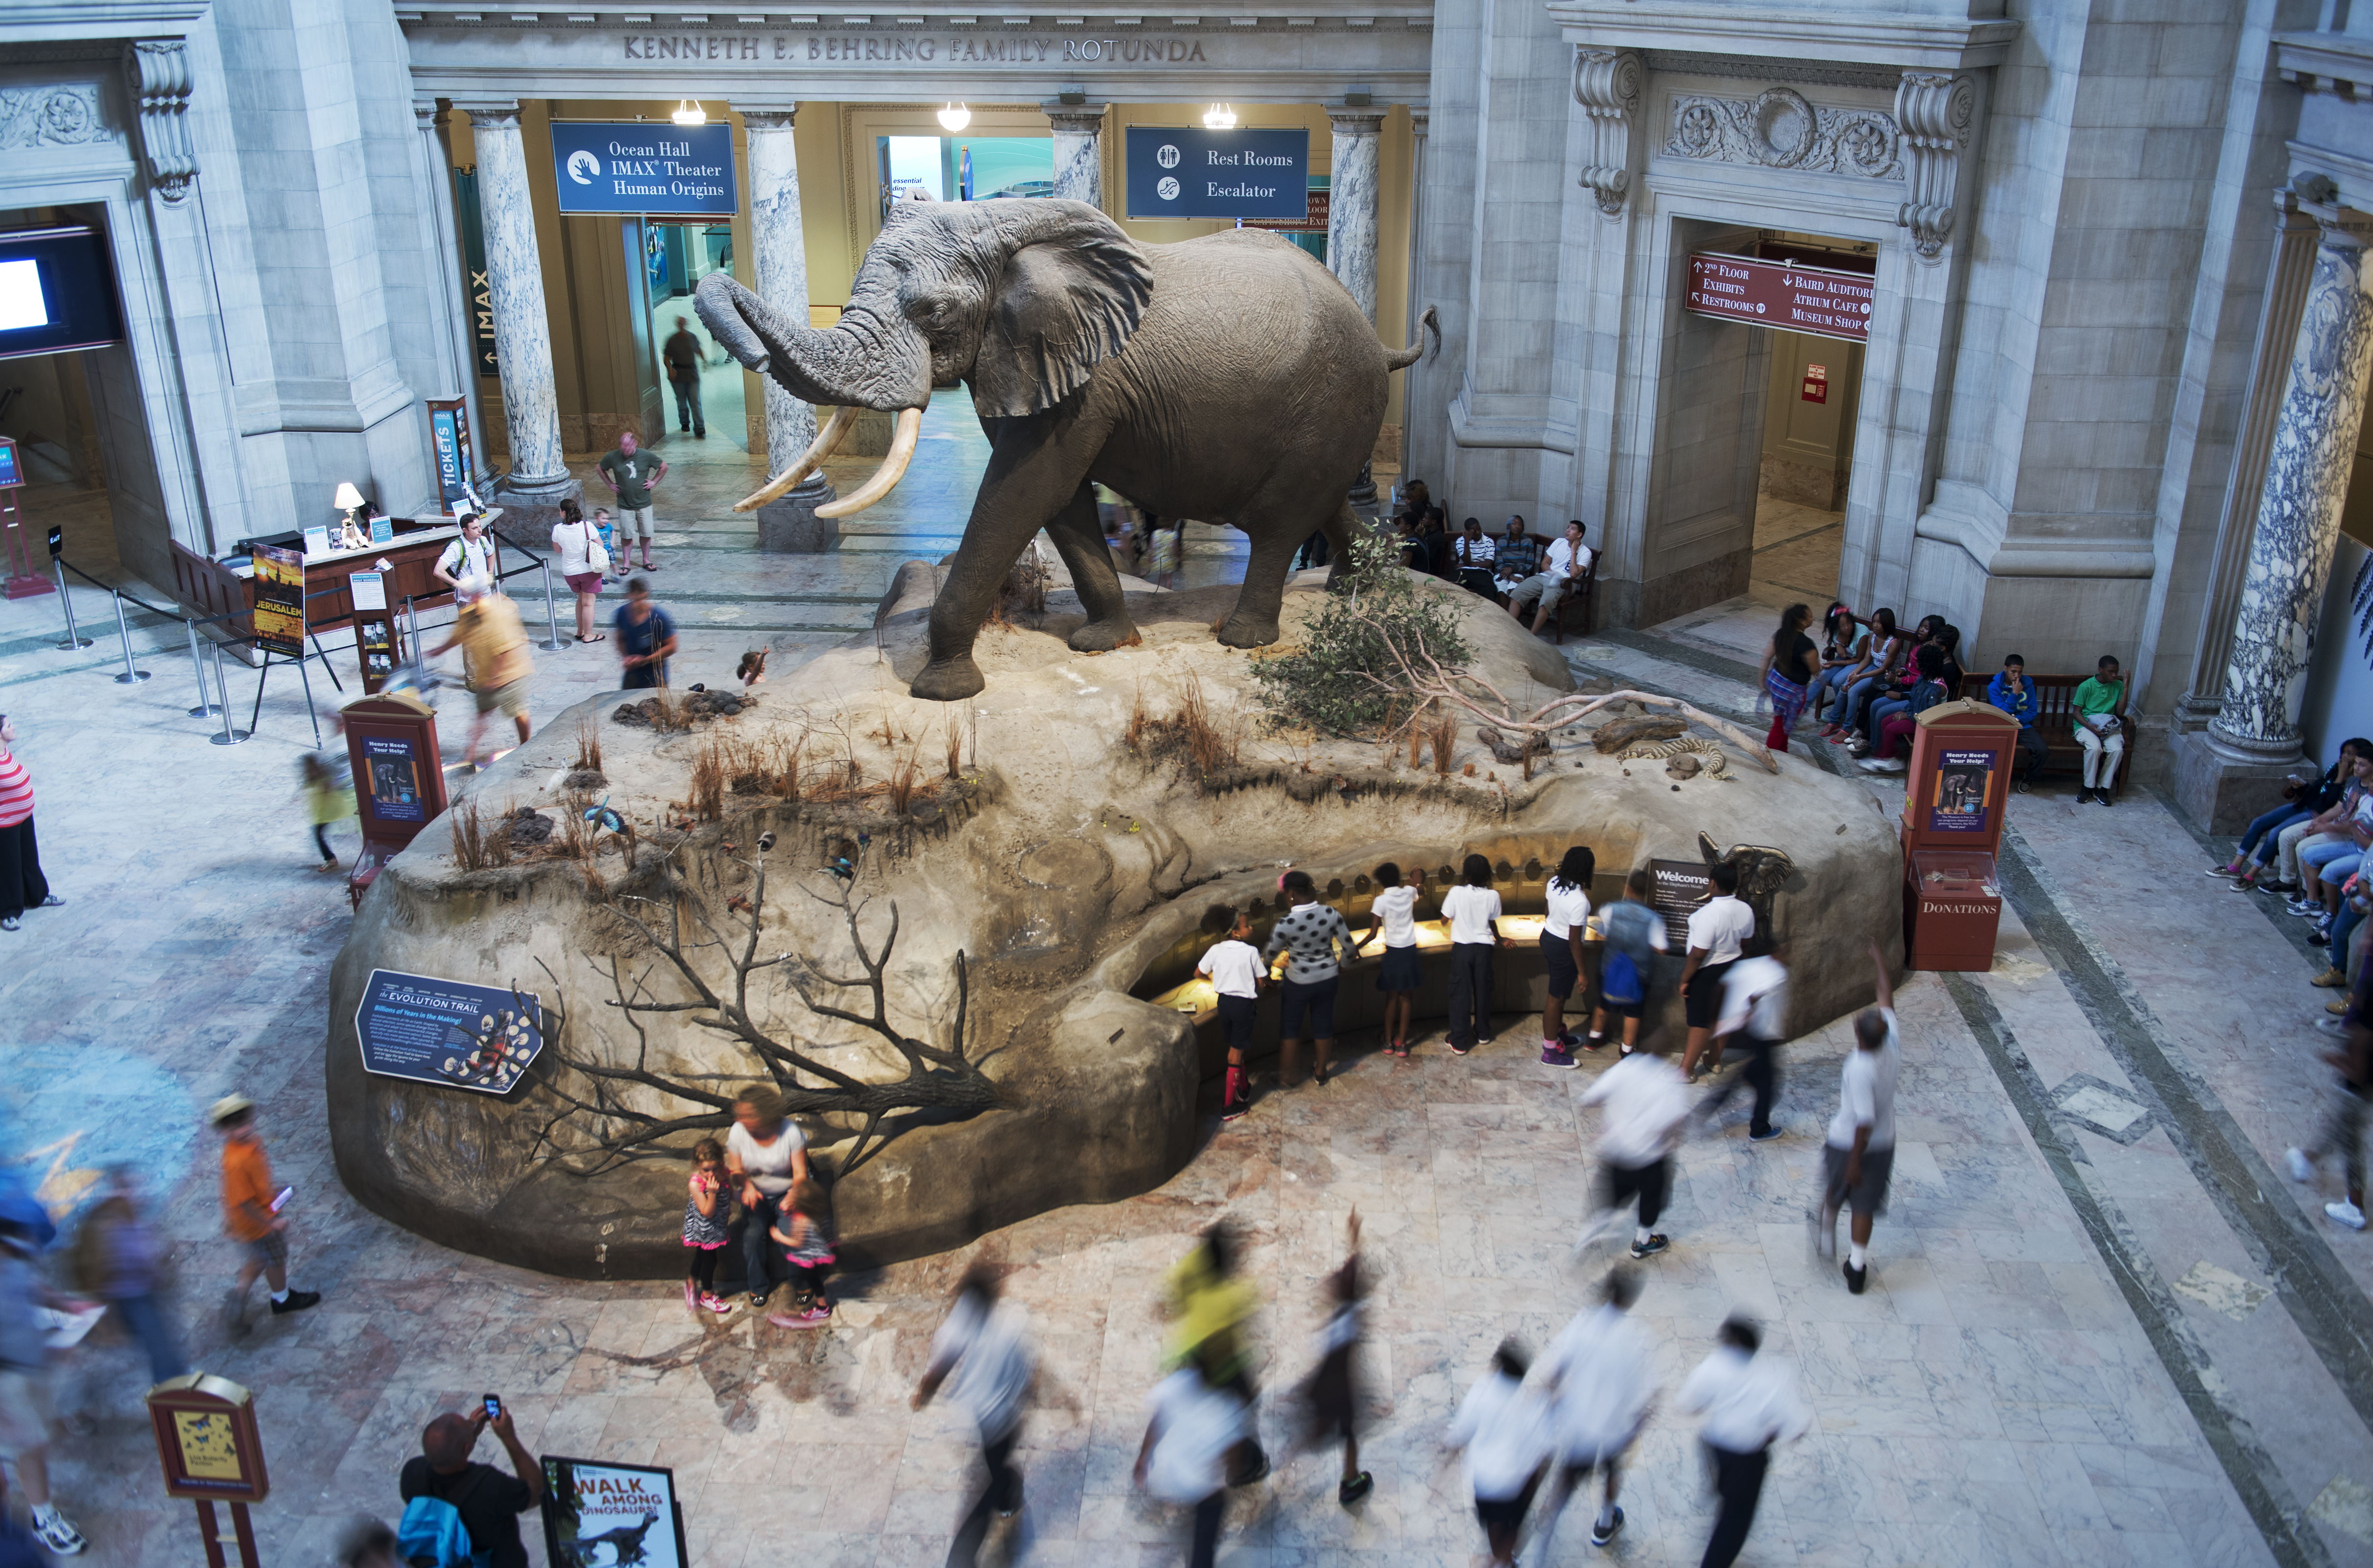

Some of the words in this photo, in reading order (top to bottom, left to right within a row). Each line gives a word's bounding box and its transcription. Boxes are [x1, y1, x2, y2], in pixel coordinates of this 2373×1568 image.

[624, 36, 759, 60] KENNETH
[773, 38, 795, 60] E.
[807, 37, 935, 62] BEHRING
[949, 39, 1049, 62] FAMILY
[1062, 39, 1206, 62] ROTUNDA
[609, 142, 654, 156] Ocean
[658, 142, 690, 156] Hall
[1207, 150, 1239, 165] Rest
[1244, 151, 1293, 166] Rooms
[664, 162, 722, 176] Theater
[613, 180, 667, 195] Human
[671, 181, 724, 199] Origins
[1207, 182, 1276, 197] Escalator
[1719, 265, 1749, 280] FLOOR
[1703, 278, 1745, 295] EXHIBITS
[1795, 276, 1824, 291] BAIRD
[472, 270, 495, 339] IMAX
[1702, 293, 1755, 312] RESTROOMS
[1793, 292, 1830, 309] ATRIUM
[1833, 298, 1858, 313] CAFE
[1791, 308, 1833, 325] MUSEUM
[1835, 315, 1861, 330] SHOP
[438, 427, 456, 486] TICKETS
[256, 600, 302, 617] JERUSALEM
[1656, 870, 1709, 884] Welcome
[1922, 902, 1997, 914] DONATIONS
[389, 992, 449, 1009] EVOLUTION
[451, 1002, 479, 1013] TRAIL
[374, 1004, 395, 1014] Billions
[437, 1015, 462, 1025] Making!
[574, 1478, 645, 1495] WALK
[602, 1494, 663, 1505] AMONG
[581, 1506, 658, 1516] DINOSAURS!
